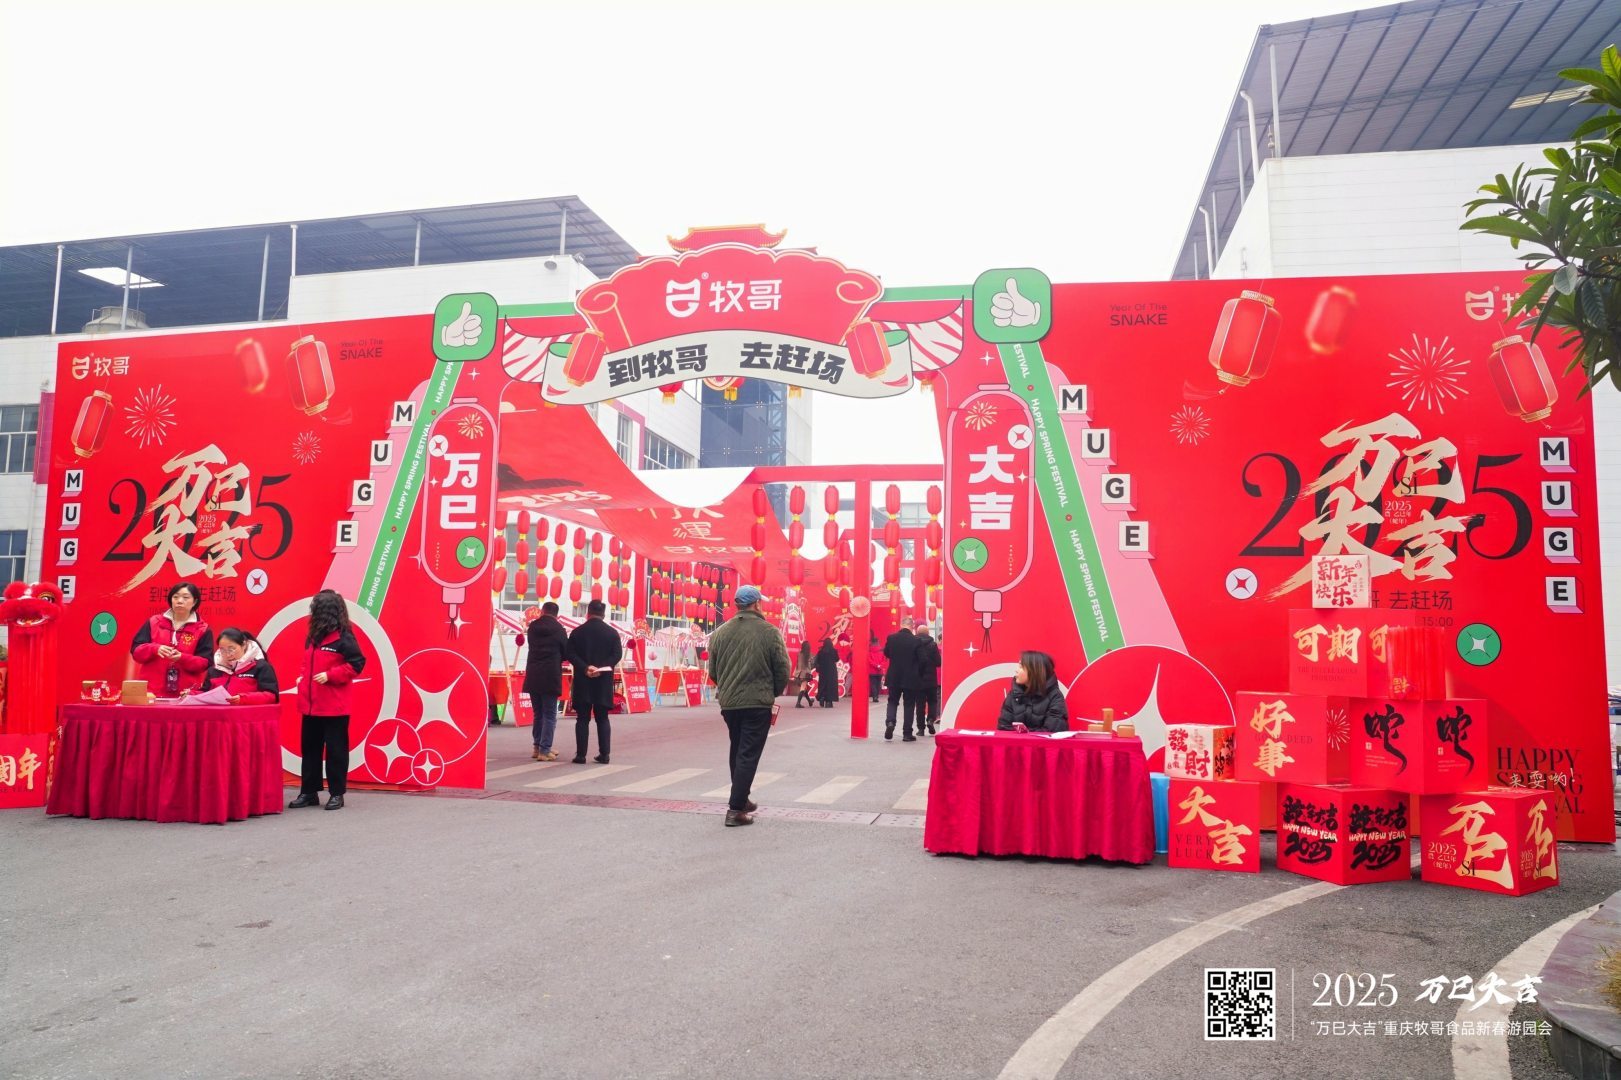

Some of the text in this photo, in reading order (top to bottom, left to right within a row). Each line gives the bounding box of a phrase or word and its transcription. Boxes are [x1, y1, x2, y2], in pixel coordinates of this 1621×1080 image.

[709, 278, 783, 314] 牧哥
[1149, 302, 1168, 311] The
[1110, 313, 1168, 326] SNAKE
[93, 356, 130, 377] 牧哥
[340, 347, 383, 360] SNAKE
[607, 341, 847, 388] 到牧哥 去赶场
[1013, 343, 1031, 378] ESTIVAL
[435, 376, 449, 403] HAPPY
[396, 422, 432, 519] HAPPY SPRING FESTIVAL
[1031, 398, 1069, 508] HAPPY SPRING FESTIVAL
[968, 445, 1015, 530] 大吉
[1385, 500, 1412, 511] 2025
[102, 503, 262, 598] 大吉
[1258, 486, 1482, 602] 大吉
[366, 577, 381, 607] SPRING
[376, 539, 393, 577] FESTIVAL
[1069, 529, 1108, 642] HAPPY SPRING FESTIVAL
[1316, 557, 1358, 583] 新年
[1315, 582, 1354, 607] 快乐
[1389, 590, 1453, 611] 去赶场
[1293, 623, 1362, 664] 可期
[1369, 624, 1389, 663] 可
[1168, 728, 1211, 778] 發財
[1250, 699, 1296, 777] 好事
[1363, 704, 1408, 776] 蛇
[1436, 705, 1475, 777] 蛇
[1496, 747, 1583, 771] HAPPY
[1177, 785, 1253, 865] 大吉
[1319, 829, 1338, 842] YEAR
[1349, 830, 1407, 842] HAPPY NEW YEAR
[1428, 841, 1457, 855] 2025
